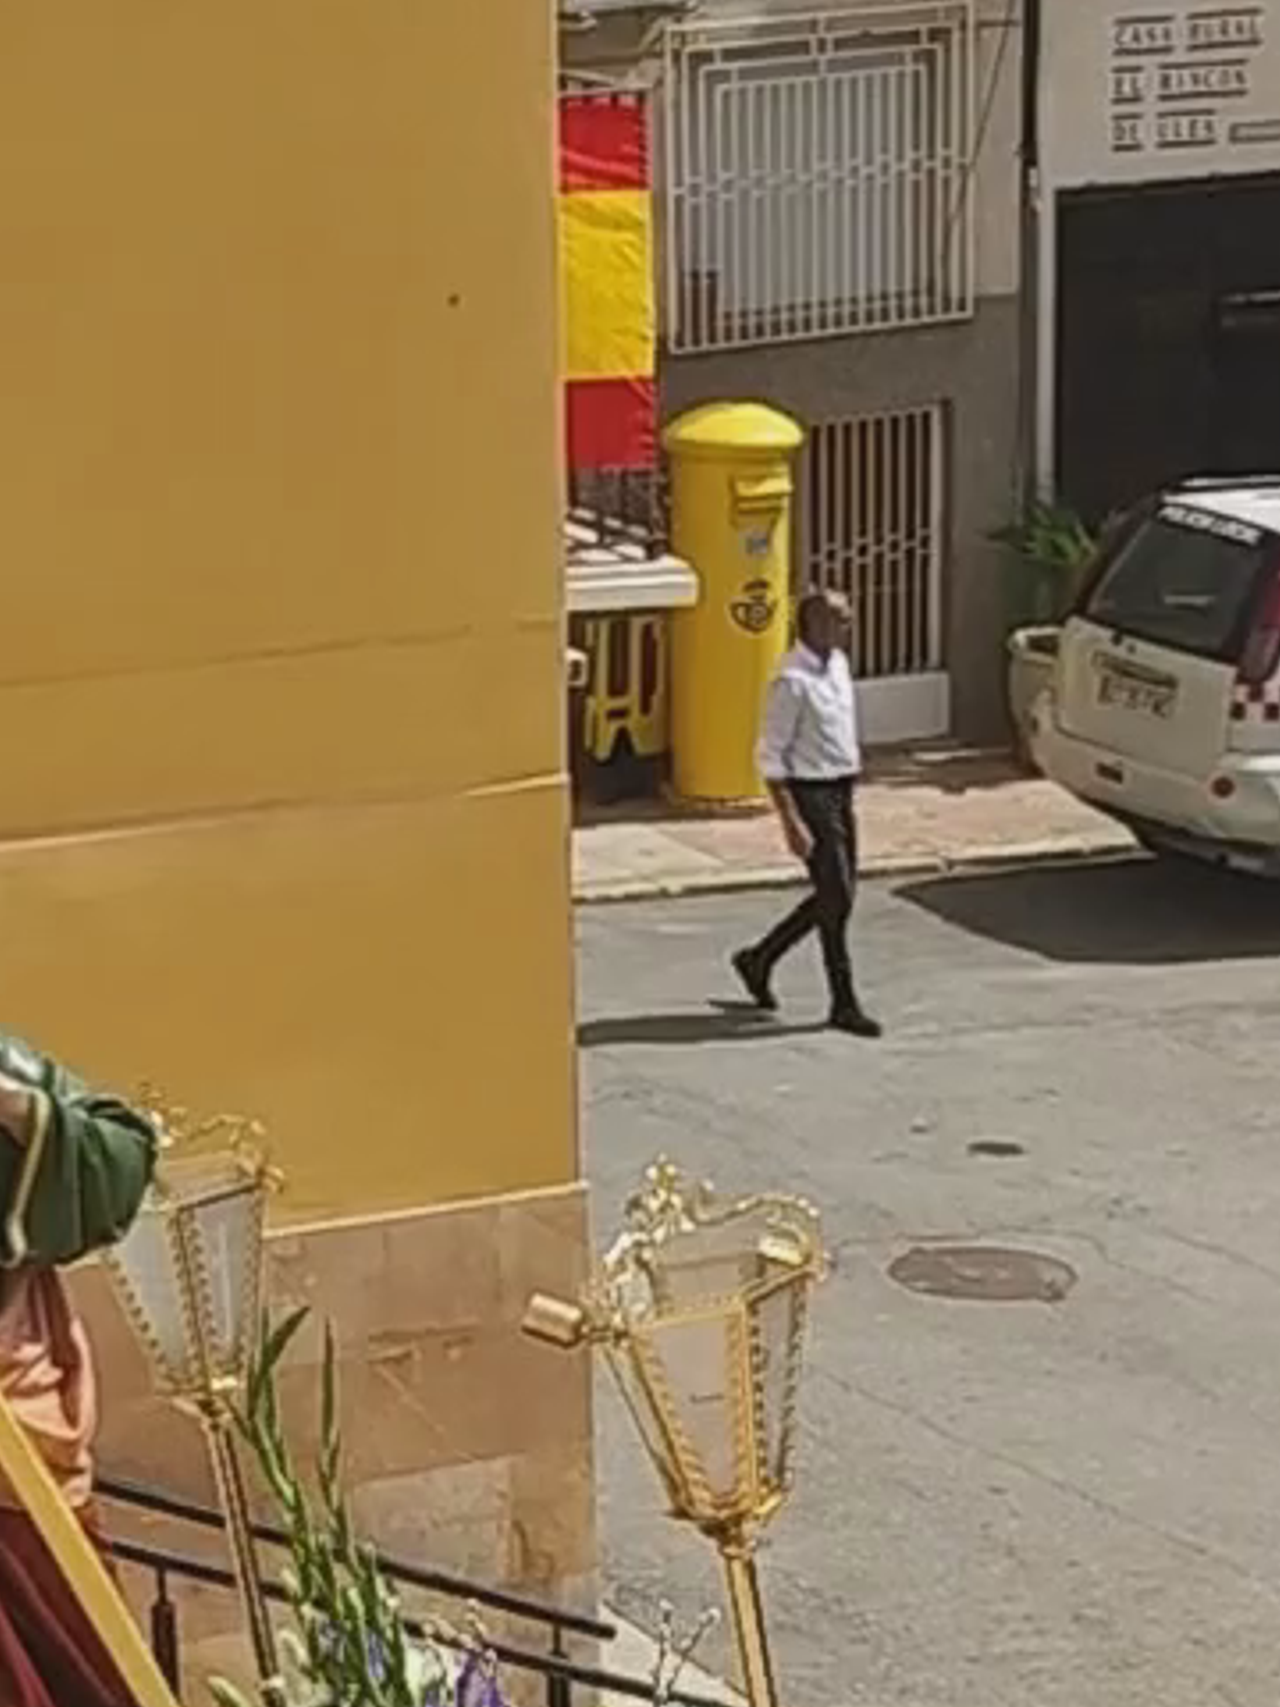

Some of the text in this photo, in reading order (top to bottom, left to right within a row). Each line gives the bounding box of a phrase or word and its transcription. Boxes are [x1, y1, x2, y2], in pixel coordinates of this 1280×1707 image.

[1113, 22, 1172, 48] CASA
[1113, 72, 1141, 98] EL
[1112, 119, 1139, 142] DE
